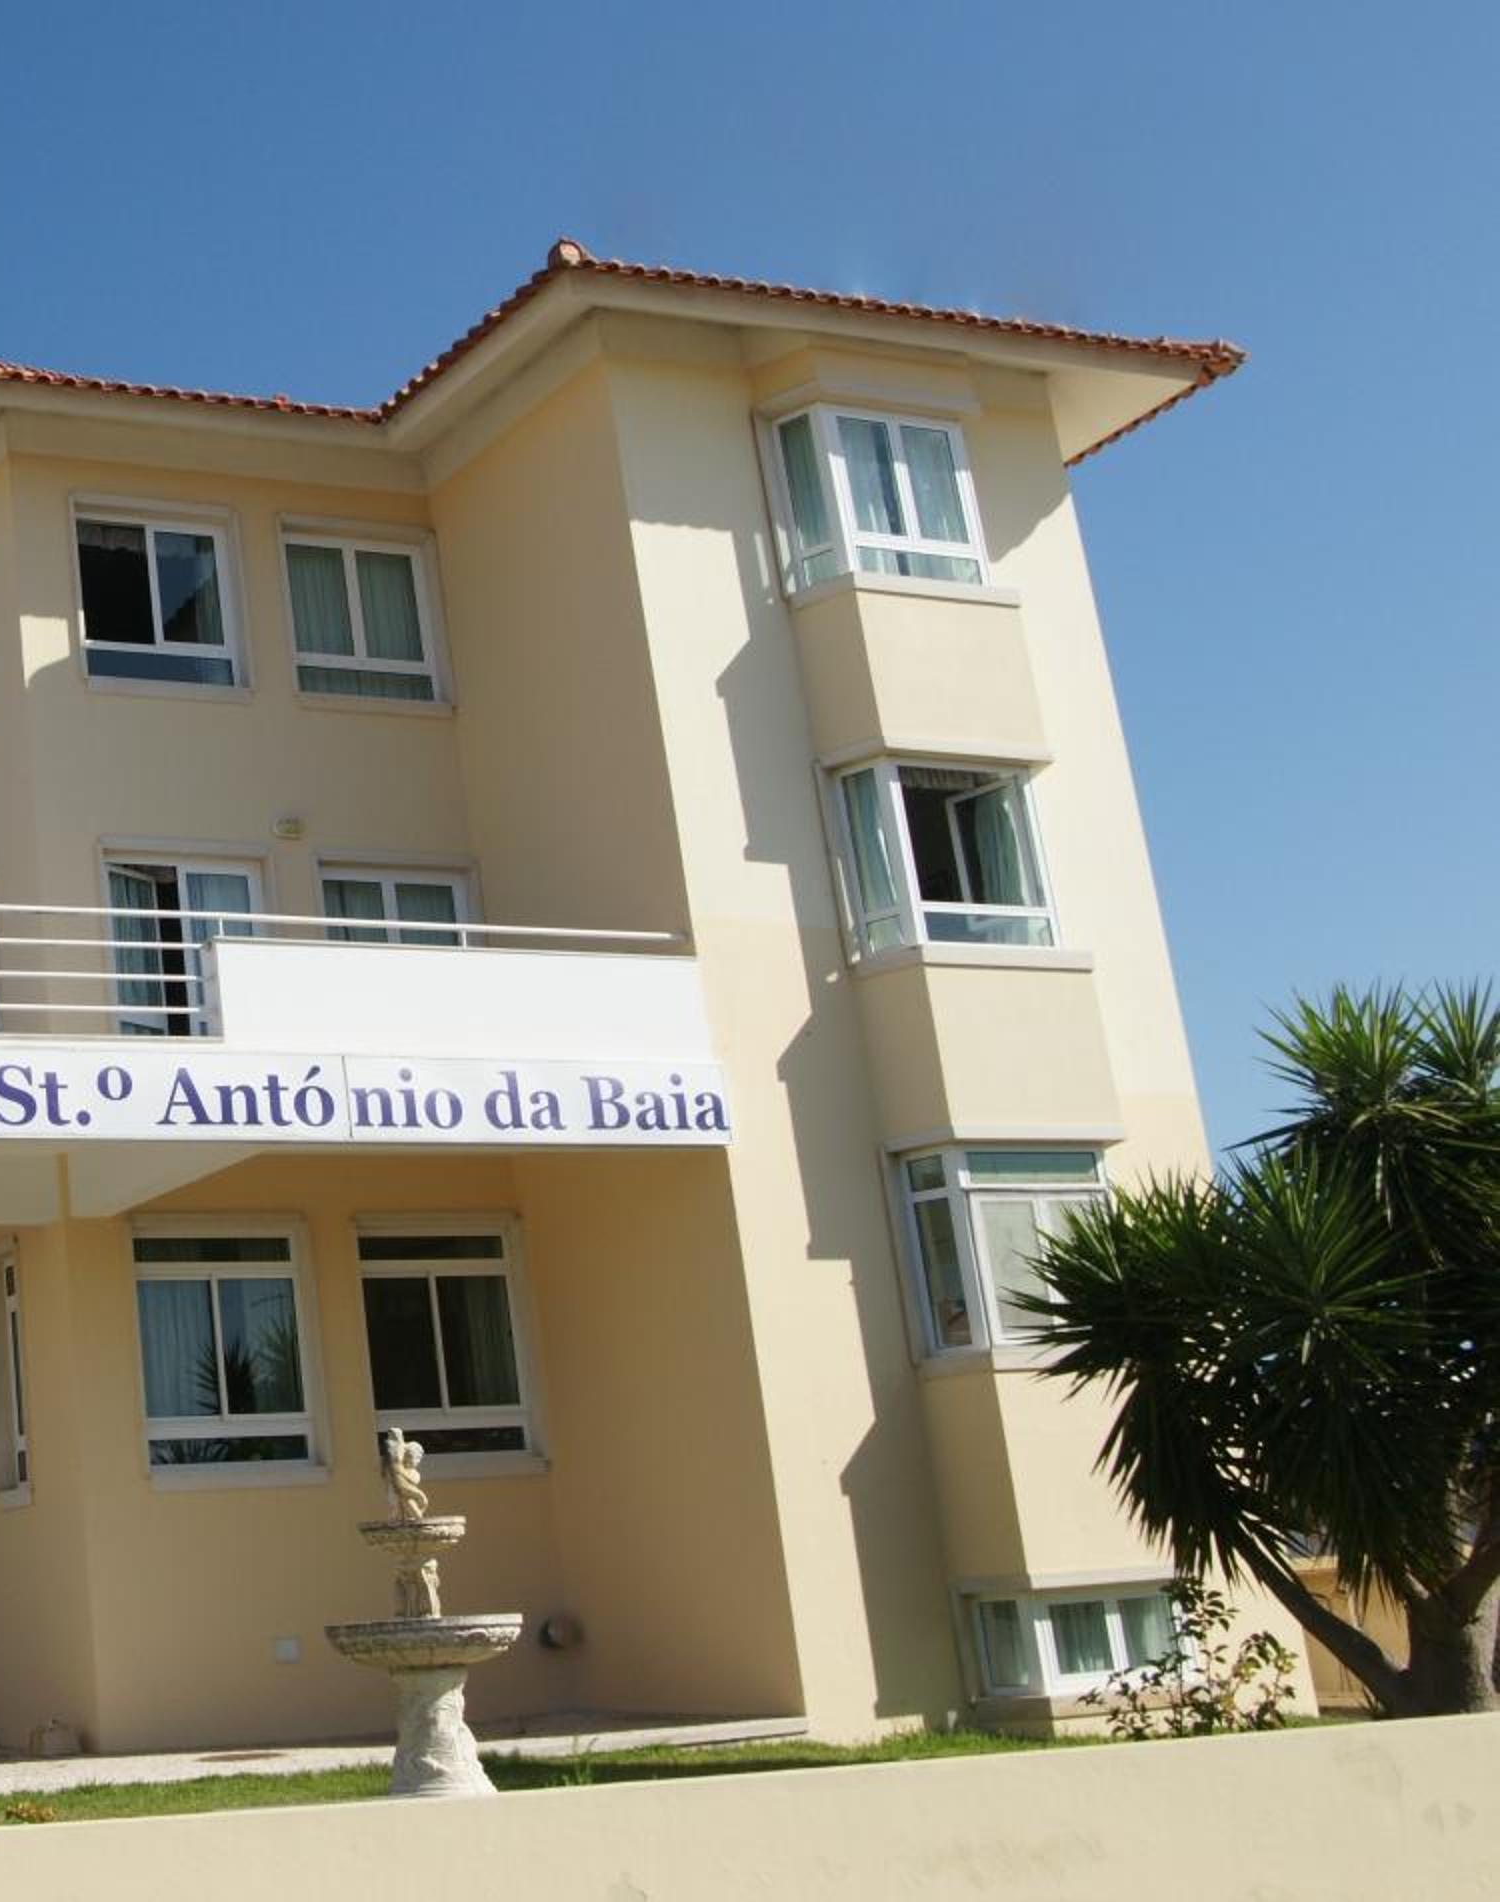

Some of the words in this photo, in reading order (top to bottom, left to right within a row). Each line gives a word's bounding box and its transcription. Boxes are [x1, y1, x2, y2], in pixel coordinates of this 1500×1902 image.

[155, 1065, 463, 1129] António
[484, 1070, 567, 1130] da
[580, 1073, 730, 1132] Baia
